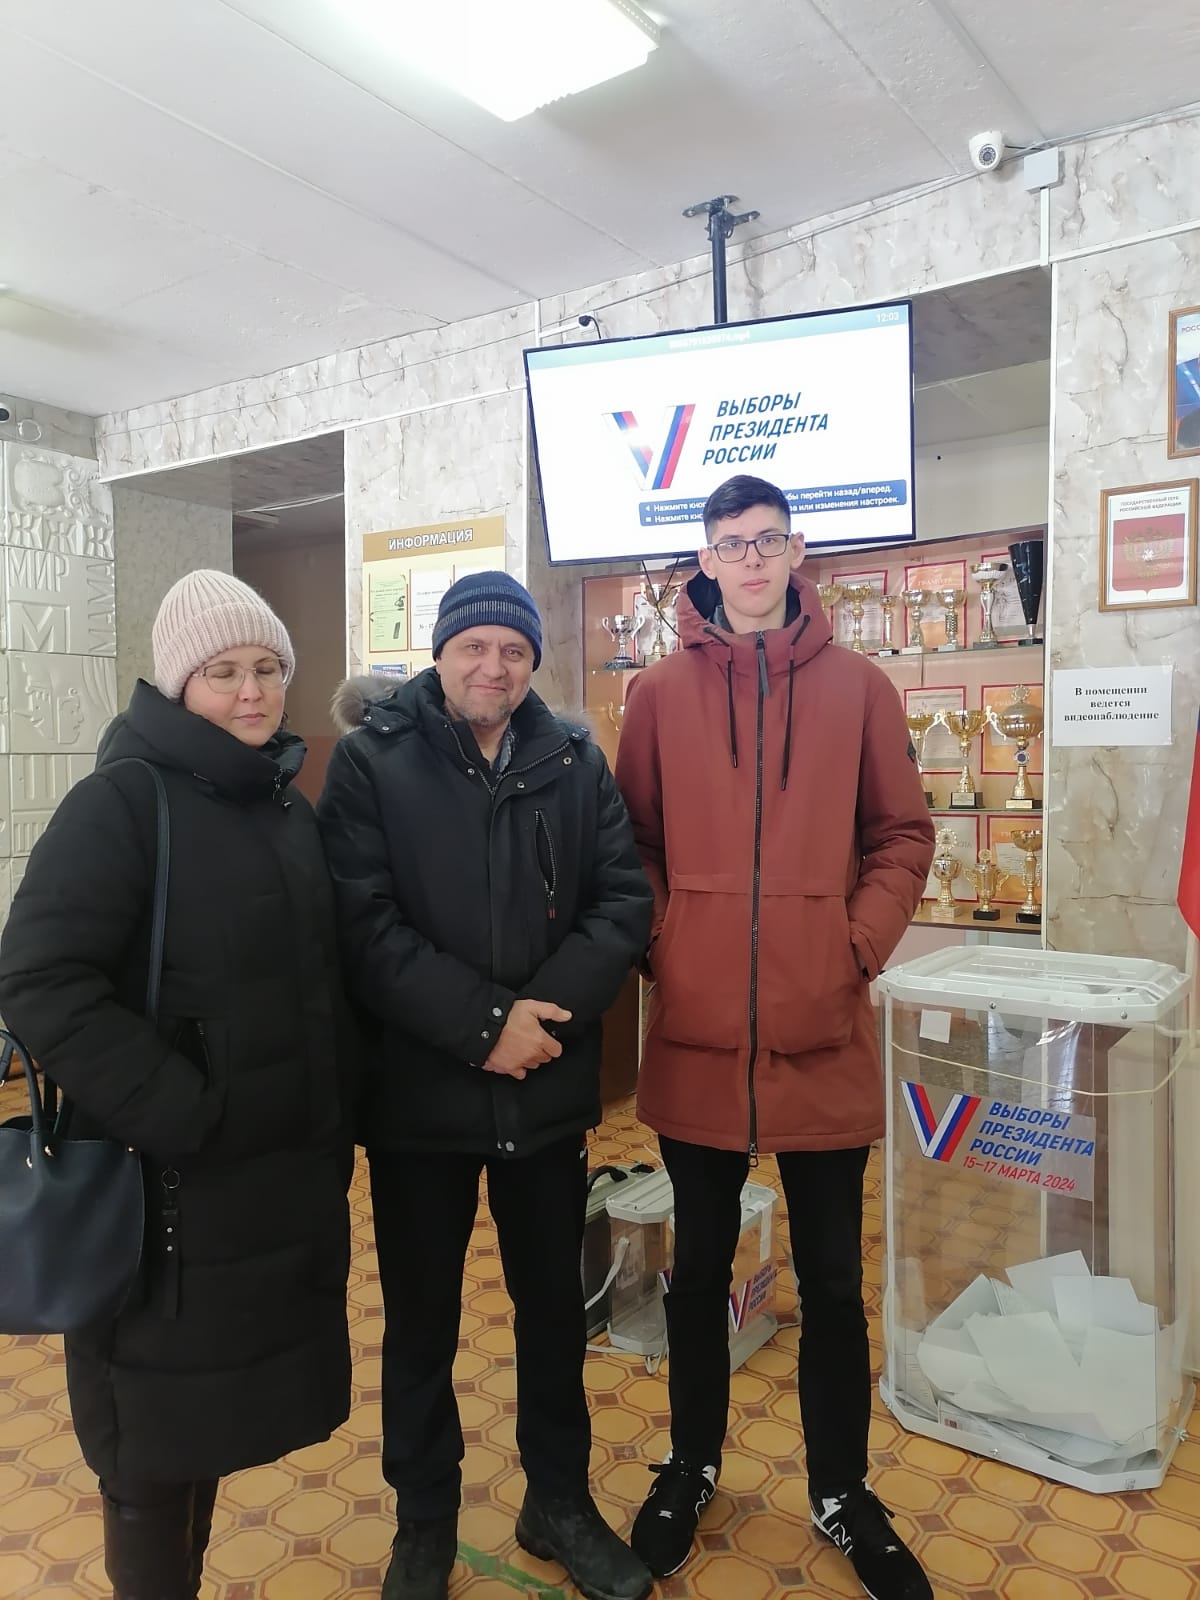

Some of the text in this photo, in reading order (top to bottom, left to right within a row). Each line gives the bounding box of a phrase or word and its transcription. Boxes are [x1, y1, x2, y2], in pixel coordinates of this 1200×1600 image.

[716, 391, 802, 418] ВЫБОРЫ
[708, 413, 829, 442] ПРЕЗИДЕНТА
[702, 442, 778, 466] РОССИИ
[800, 490, 833, 501] перейти
[388, 528, 474, 551] ИНФОРМАЦИЯ
[8, 548, 70, 593] МИР
[1075, 687, 1148, 696] В помещении
[1090, 700, 1131, 708] ведется
[1064, 711, 1160, 722] видеонаблюдение
[988, 1102, 1071, 1130] ВЫБОРЫ
[979, 1120, 1095, 1156] ПРЕЗИДЕНТА
[969, 1138, 1042, 1166] РОССИИ
[997, 1164, 1041, 1185] МАРТА
[1042, 1174, 1077, 1191] 2024
